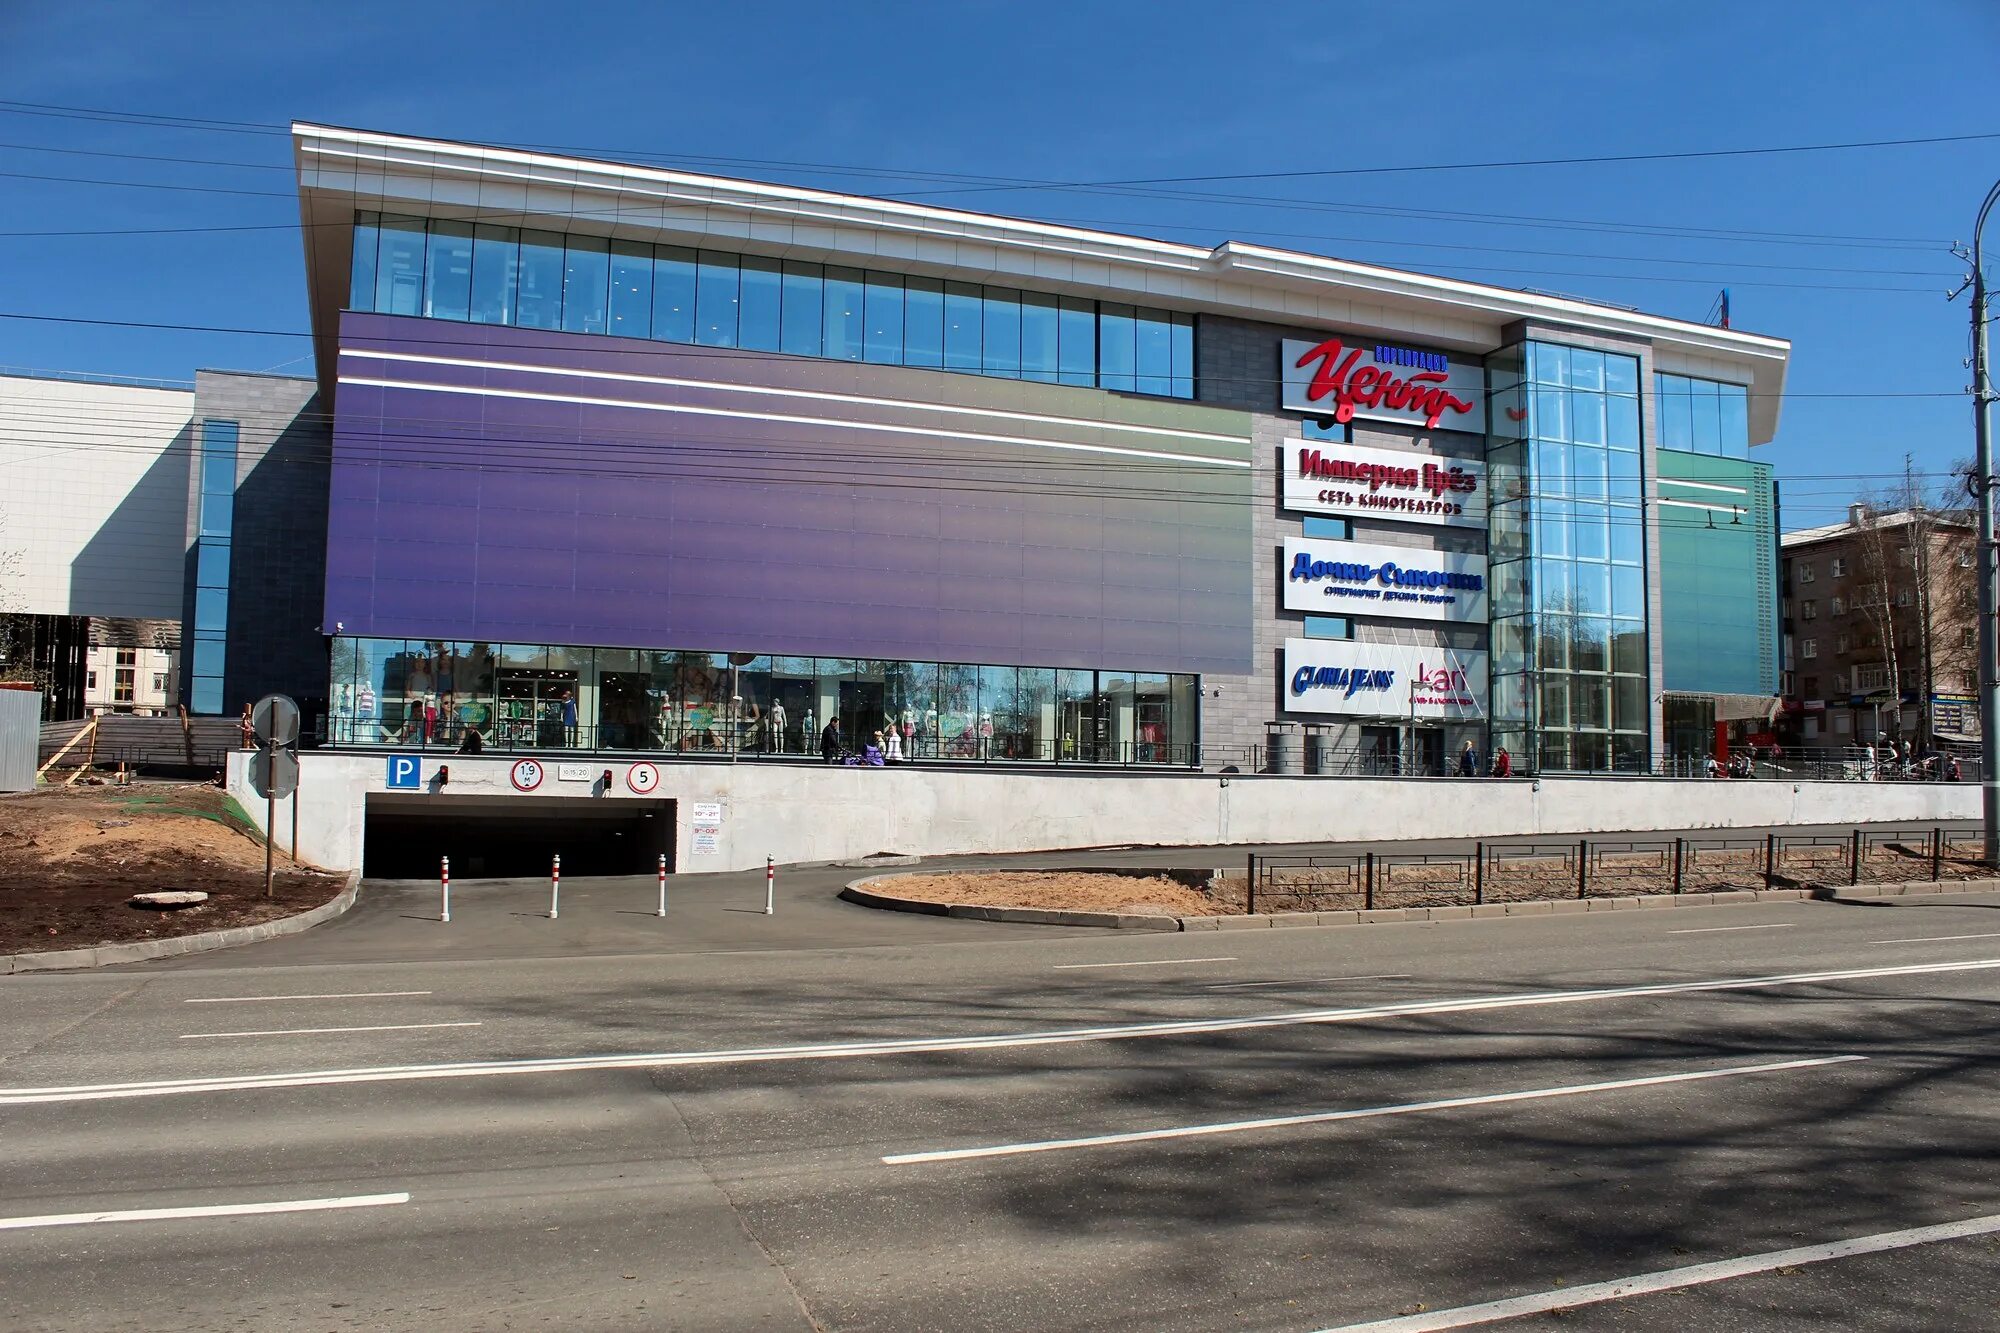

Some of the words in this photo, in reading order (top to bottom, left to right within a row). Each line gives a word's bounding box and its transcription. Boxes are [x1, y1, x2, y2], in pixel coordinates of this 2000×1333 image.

[1296, 338, 1474, 429] Центр
[1298, 448, 1419, 492] Империя
[1421, 462, 1477, 497] Грёз
[1318, 489, 1354, 507] СЕТЬ
[1358, 493, 1463, 515] КИНОТЕАТРОВ
[1291, 552, 1484, 592] Дочки-Сыночки
[1418, 662, 1467, 693] kari
[520, 765, 536, 776] 1,9
[639, 770, 648, 783] 5
